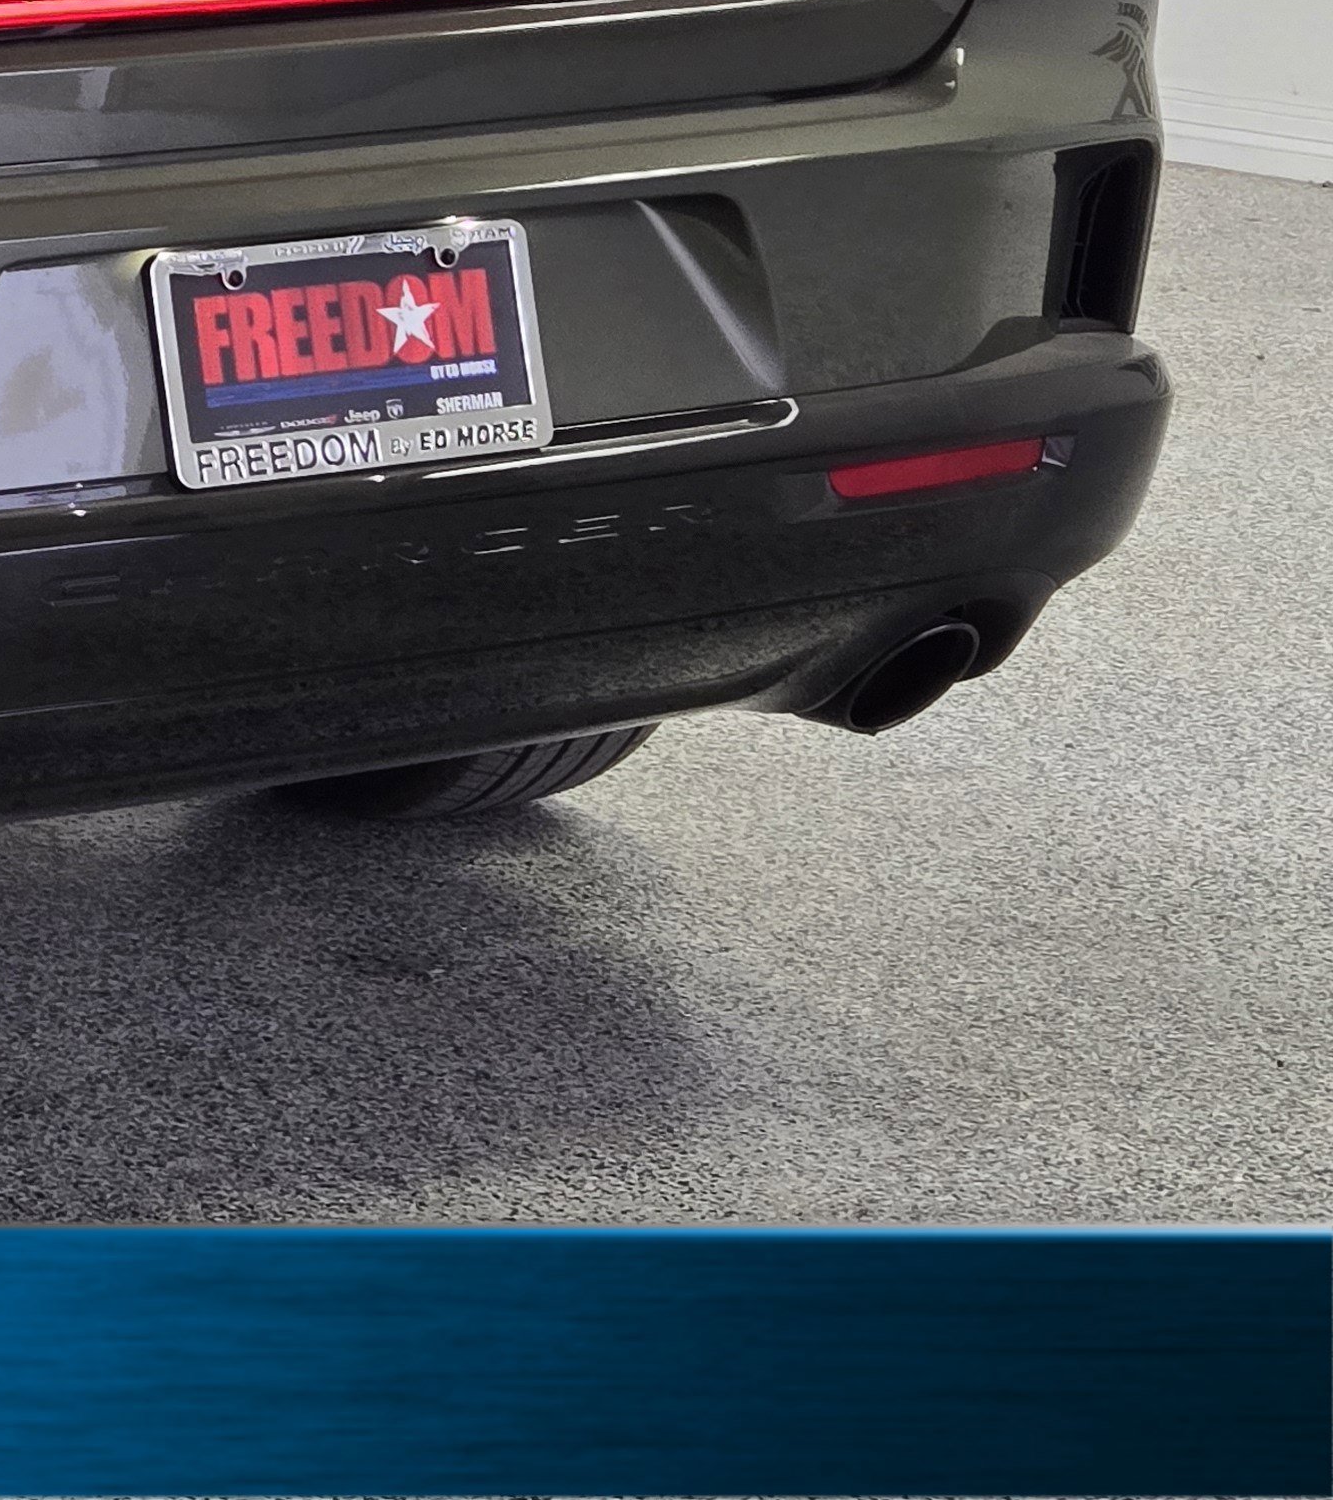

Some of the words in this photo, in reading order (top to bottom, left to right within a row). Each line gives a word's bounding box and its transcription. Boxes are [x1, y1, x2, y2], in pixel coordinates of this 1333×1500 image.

[192, 267, 496, 385] FREEDOM
[343, 409, 381, 424] Jeep
[435, 391, 504, 415] SHERMAN
[195, 427, 383, 484] FREEDOM
[419, 428, 448, 452] ED
[456, 417, 536, 448] MORSE
